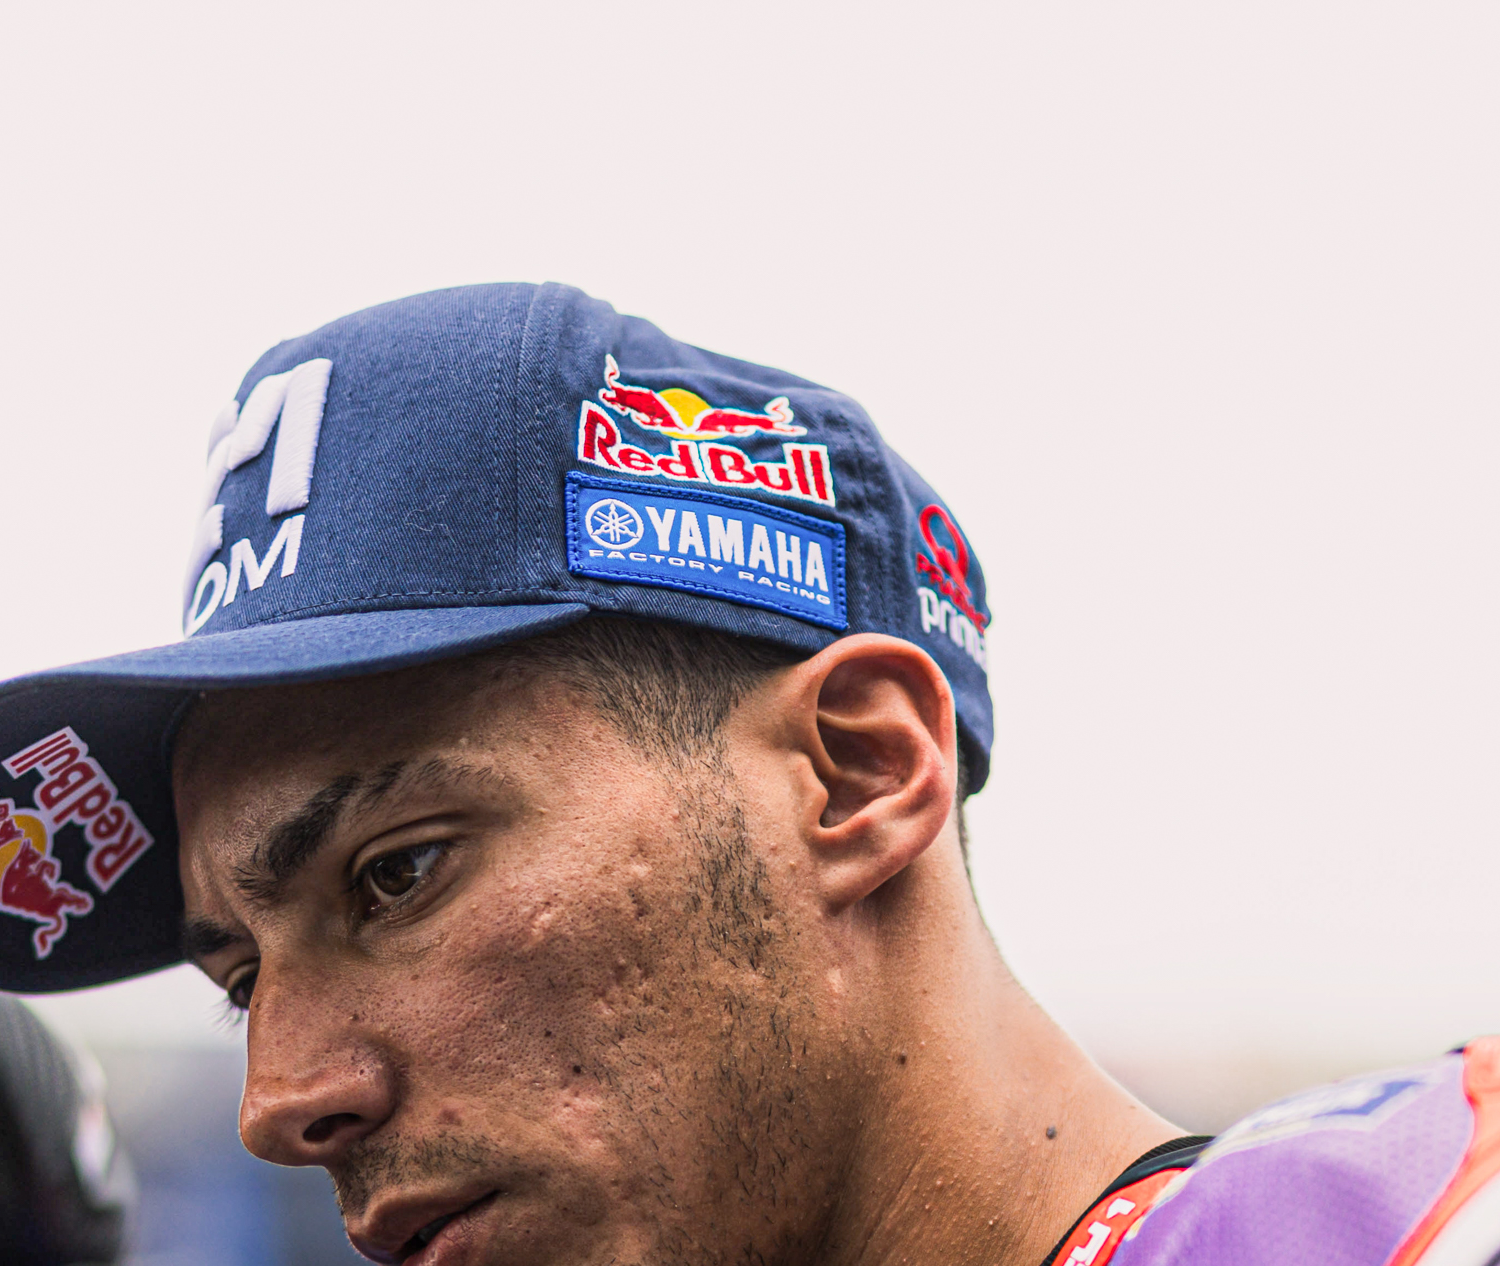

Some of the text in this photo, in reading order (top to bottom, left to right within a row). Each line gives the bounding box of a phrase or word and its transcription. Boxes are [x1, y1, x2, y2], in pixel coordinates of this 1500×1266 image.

[580, 403, 834, 504] Red Bull
[588, 549, 832, 606] FACTORY RACING
[645, 505, 830, 593] YAMAHA
[6, 730, 150, 886] Red Bull
